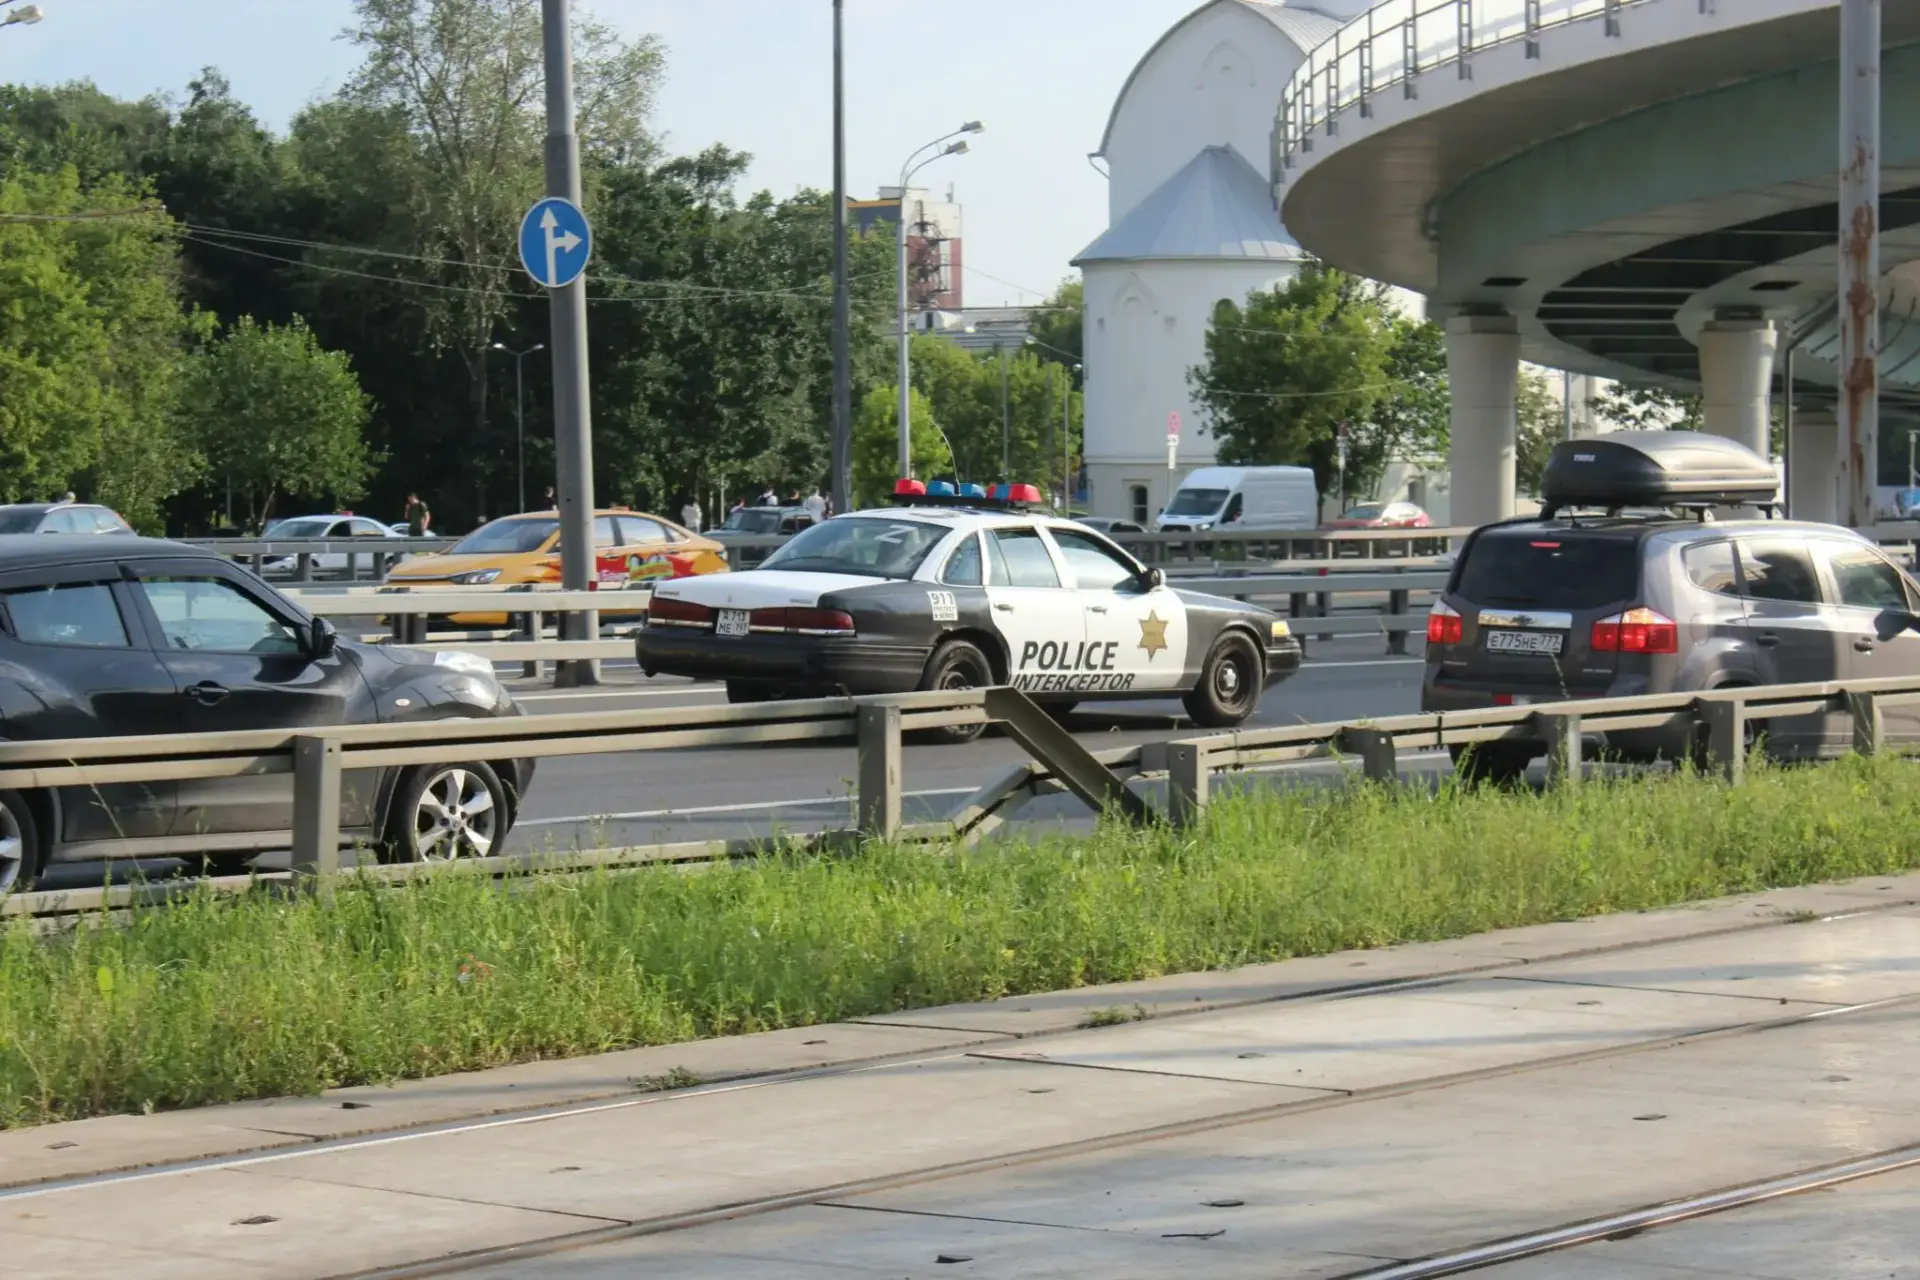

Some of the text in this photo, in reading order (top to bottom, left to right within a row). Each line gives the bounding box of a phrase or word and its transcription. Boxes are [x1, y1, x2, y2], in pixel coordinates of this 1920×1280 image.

[931, 592, 954, 605] 911
[1019, 640, 1119, 671] POLICE
[1013, 673, 1136, 691] INTERCEPTOR
